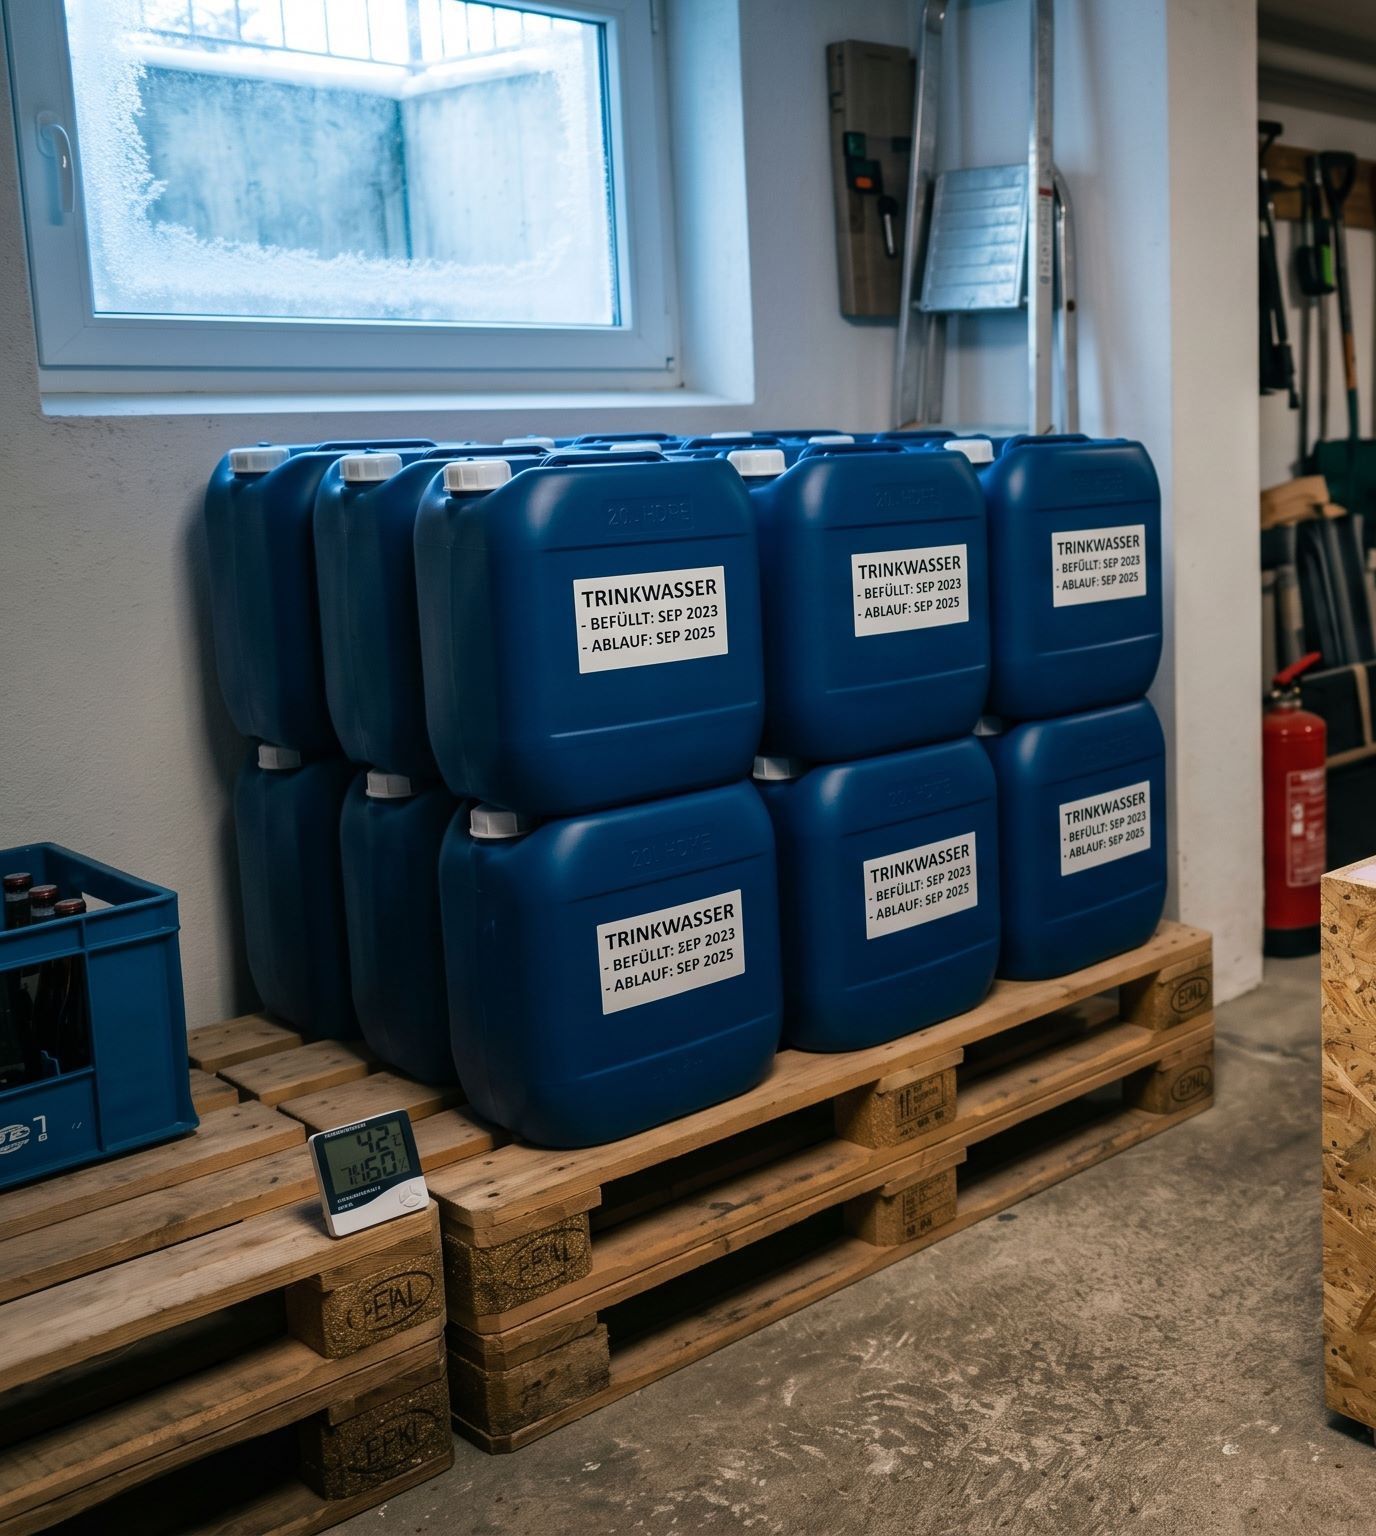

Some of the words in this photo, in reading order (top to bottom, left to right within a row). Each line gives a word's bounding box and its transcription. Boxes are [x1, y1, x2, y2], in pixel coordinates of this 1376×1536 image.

[1056, 533, 1140, 555] TRINKWASSER
[857, 555, 961, 579] TRINKWASSER
[1102, 557, 1118, 569] SEP
[1120, 554, 1140, 567] 2023
[864, 582, 913, 599] BEFÜLLT:
[915, 580, 934, 594] SEP
[937, 577, 961, 591] 2023
[1100, 574, 1116, 586] SEP
[1118, 571, 1139, 584] 2025
[580, 578, 717, 608] TRINKWASSER
[590, 611, 654, 631] BEFÜLLT:
[657, 608, 682, 623] SEP
[686, 604, 718, 620] 2023
[864, 602, 911, 619] ABLAUF:
[913, 599, 932, 613] SEP
[935, 596, 959, 610] 2025
[591, 633, 652, 653] ABLAUF:
[656, 629, 680, 645] SEP
[684, 625, 715, 641] 2025
[1064, 791, 1146, 825] TRINKWASSER
[1109, 816, 1125, 830] SEP
[1126, 810, 1146, 825] 2023
[1107, 832, 1123, 847] SEP
[1125, 826, 1144, 842] 2025
[869, 843, 969, 883] TRINKWASSER
[876, 879, 923, 902] BEFÜLLT:
[926, 872, 944, 888] SEP
[947, 864, 971, 881] 2023
[876, 897, 922, 920] ABLAUF:
[925, 890, 943, 906] SEP
[945, 882, 969, 899] 2025
[604, 903, 735, 950] TRINKWASSER
[613, 945, 674, 971] BEFÜLLT:
[704, 926, 735, 946] 2023
[614, 965, 673, 992] ABLAUF:
[676, 957, 699, 974] SEP
[703, 947, 733, 967] 2025
